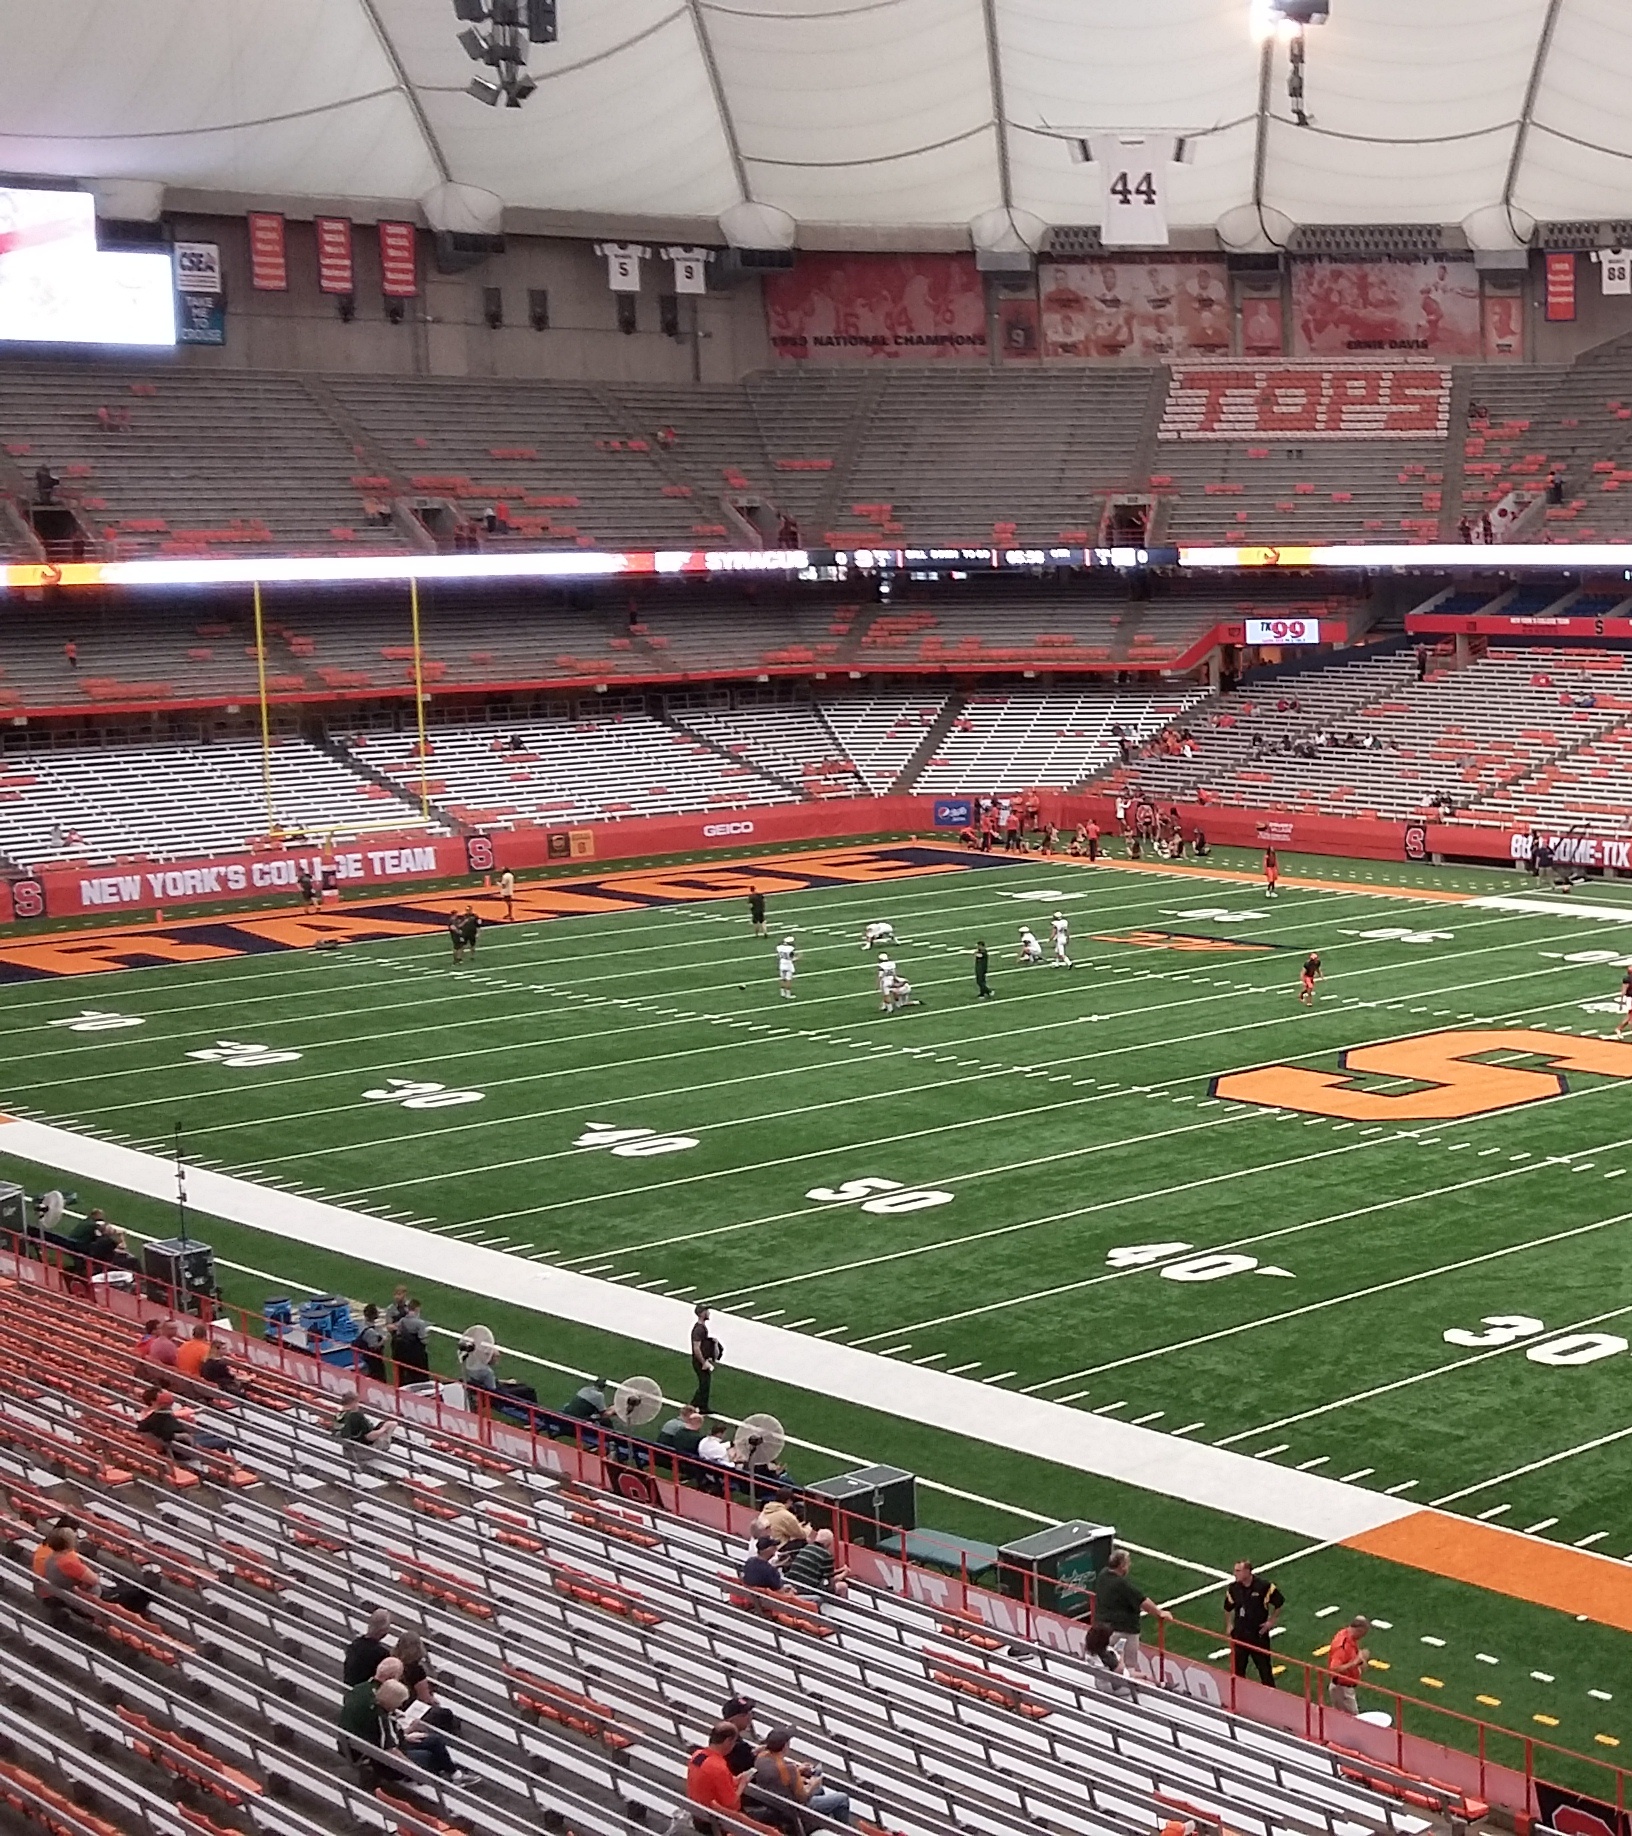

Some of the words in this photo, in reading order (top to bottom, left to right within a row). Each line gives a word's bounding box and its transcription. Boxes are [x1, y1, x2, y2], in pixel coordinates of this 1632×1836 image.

[1110, 171, 1157, 205] 44
[179, 252, 215, 273] CSEA
[619, 262, 629, 276] 5
[1608, 267, 1626, 281] 88
[186, 297, 214, 307] TAKE
[812, 335, 888, 347] NATIONAL
[894, 334, 986, 347] CHAMPIONS
[1389, 339, 1429, 349] DAVIS
[1595, 620, 1604, 635] S
[703, 821, 754, 837] GEICO
[1406, 828, 1425, 858] S
[469, 837, 493, 871] S
[80, 874, 142, 906] NEW
[147, 863, 245, 898] YORK'S
[251, 853, 365, 887] COLLGE
[368, 846, 437, 876] TEAM
[13, 880, 43, 917] S
[186, 1042, 303, 1068] 20
[361, 1080, 486, 1109] 30
[572, 1126, 699, 1158] 40
[805, 1177, 955, 1213] 50
[1106, 1241, 1259, 1282] 40
[1443, 1316, 1630, 1367] 30
